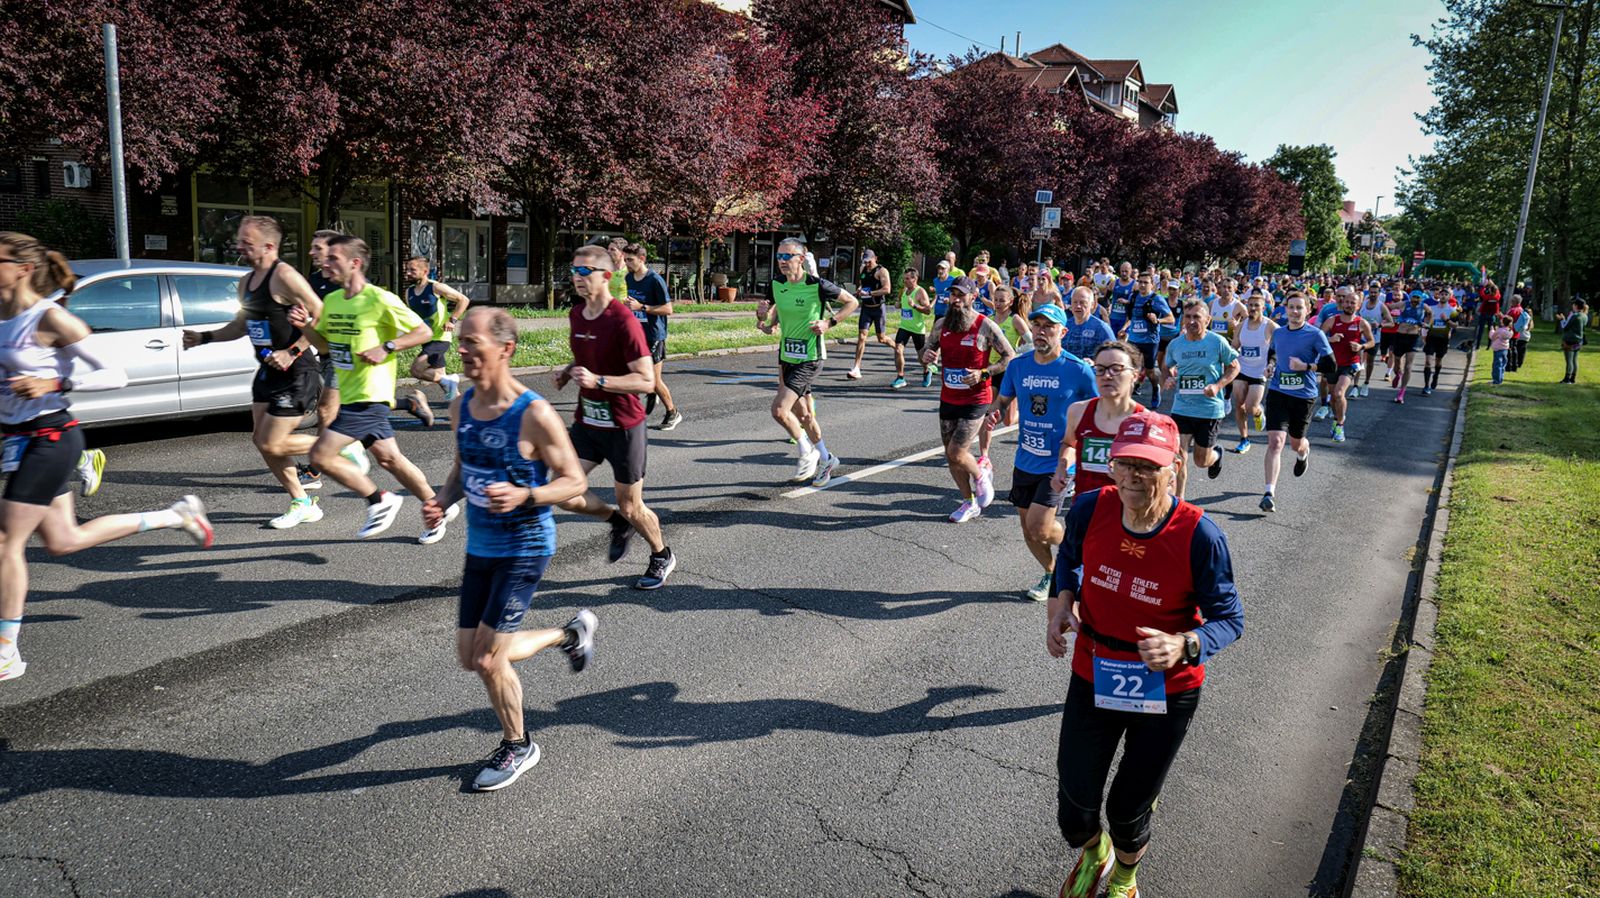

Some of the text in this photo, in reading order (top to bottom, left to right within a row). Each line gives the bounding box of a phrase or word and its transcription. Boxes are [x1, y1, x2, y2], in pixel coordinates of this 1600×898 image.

[785, 343, 806, 354] 1121
[1022, 375, 1060, 390] sljeme
[1180, 379, 1205, 389] 1136
[1280, 376, 1303, 385] 1139
[1023, 434, 1045, 449] 333
[1098, 564, 1122, 579] ATLETSKI
[1105, 575, 1121, 586] KLUB
[1132, 577, 1159, 591] ATHLETIC
[1131, 584, 1146, 595] CLUB
[1111, 674, 1145, 698] 22
